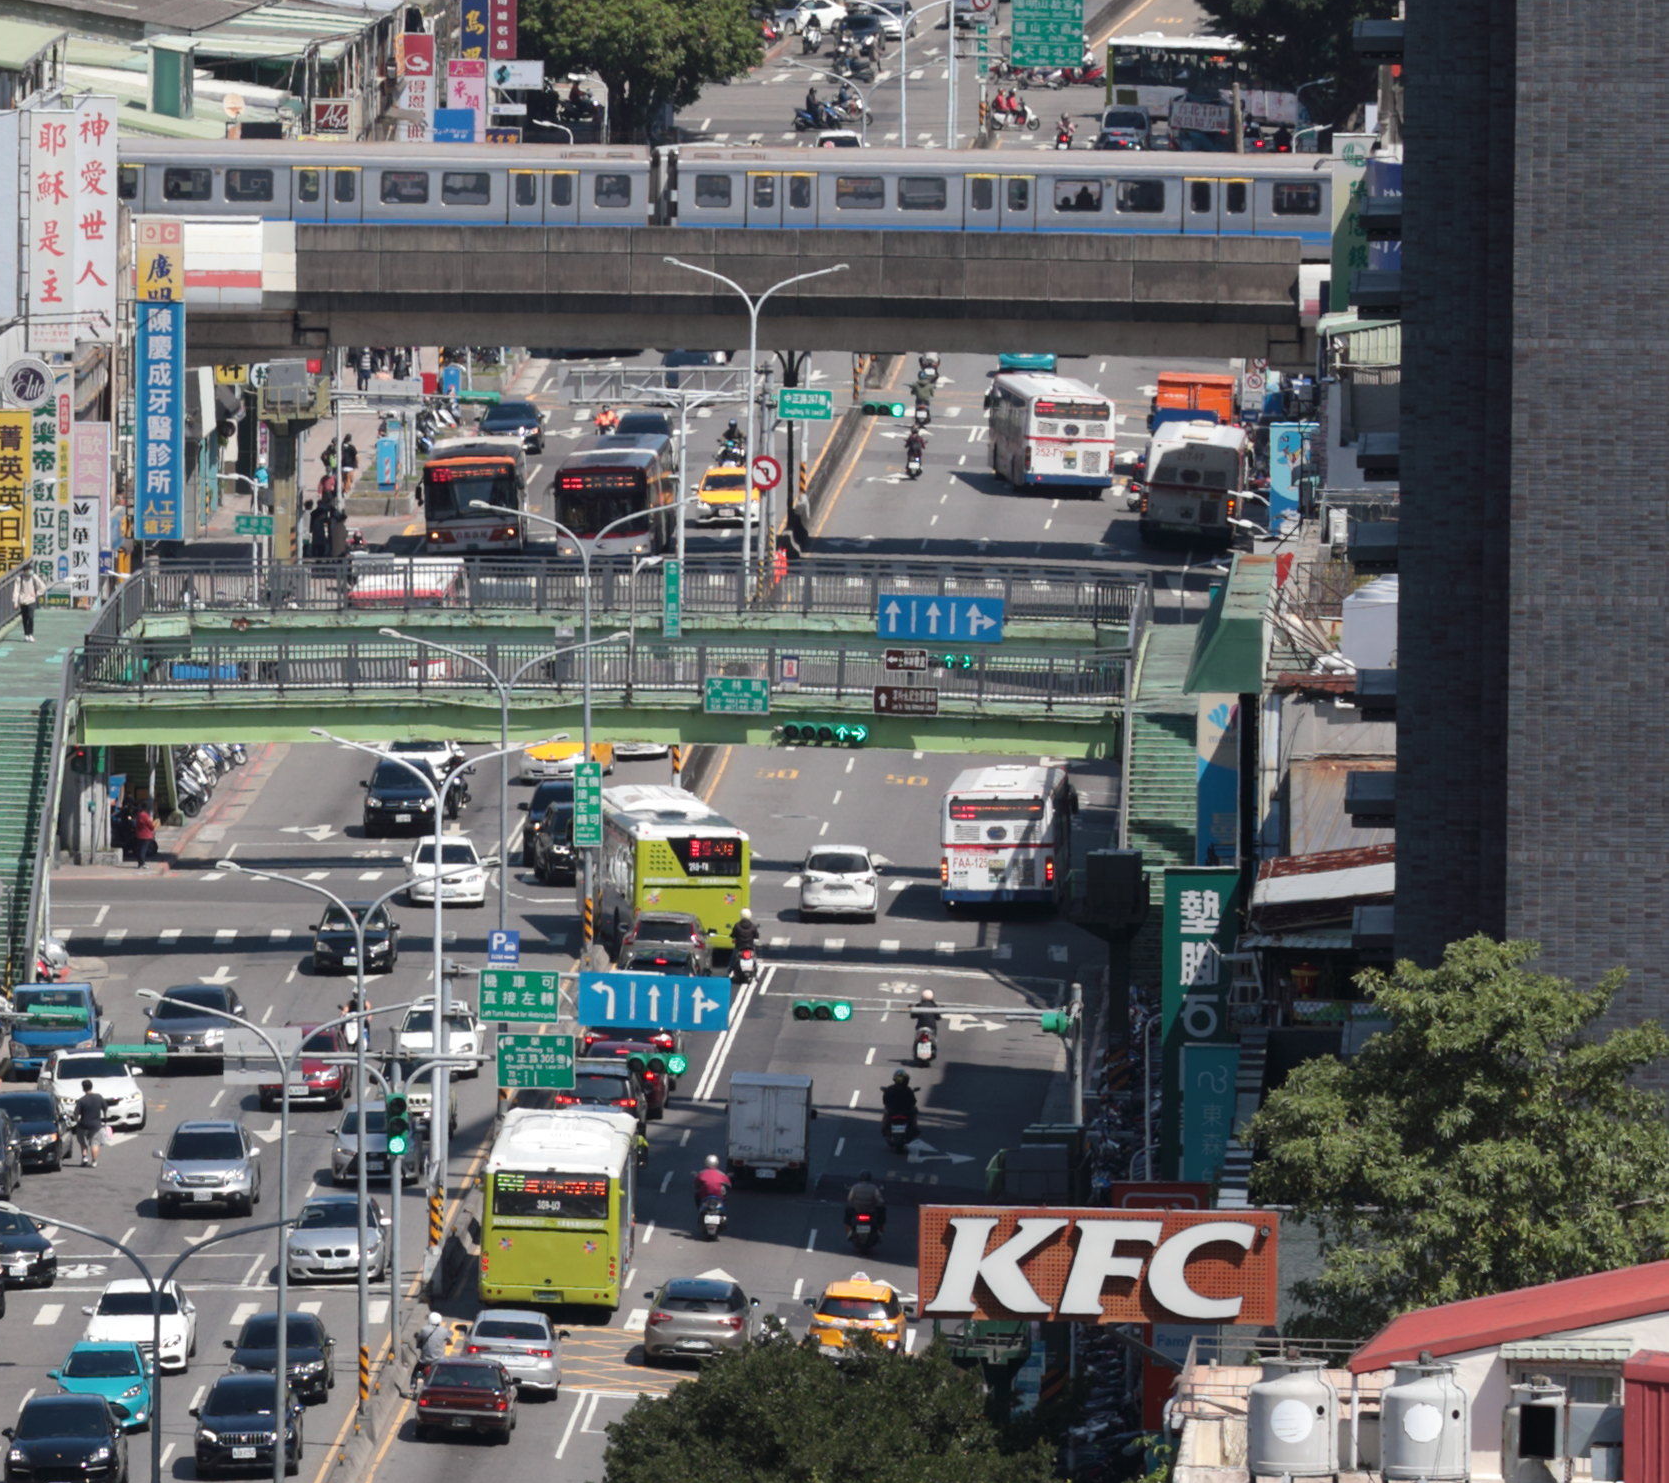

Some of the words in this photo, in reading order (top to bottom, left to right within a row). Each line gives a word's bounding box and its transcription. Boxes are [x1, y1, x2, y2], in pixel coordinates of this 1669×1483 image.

[36, 121, 70, 303] 耶穌是主
[76, 112, 112, 288] 神愛世人
[147, 309, 173, 495] 陳慶成牙醫診所
[144, 500, 174, 516] 人工
[144, 519, 174, 535] 植牙
[483, 974, 556, 990] 機車可
[483, 990, 555, 1006] 直接左轉
[1180, 890, 1220, 1038] 墊腳石
[925, 1216, 1261, 1318] KFC
